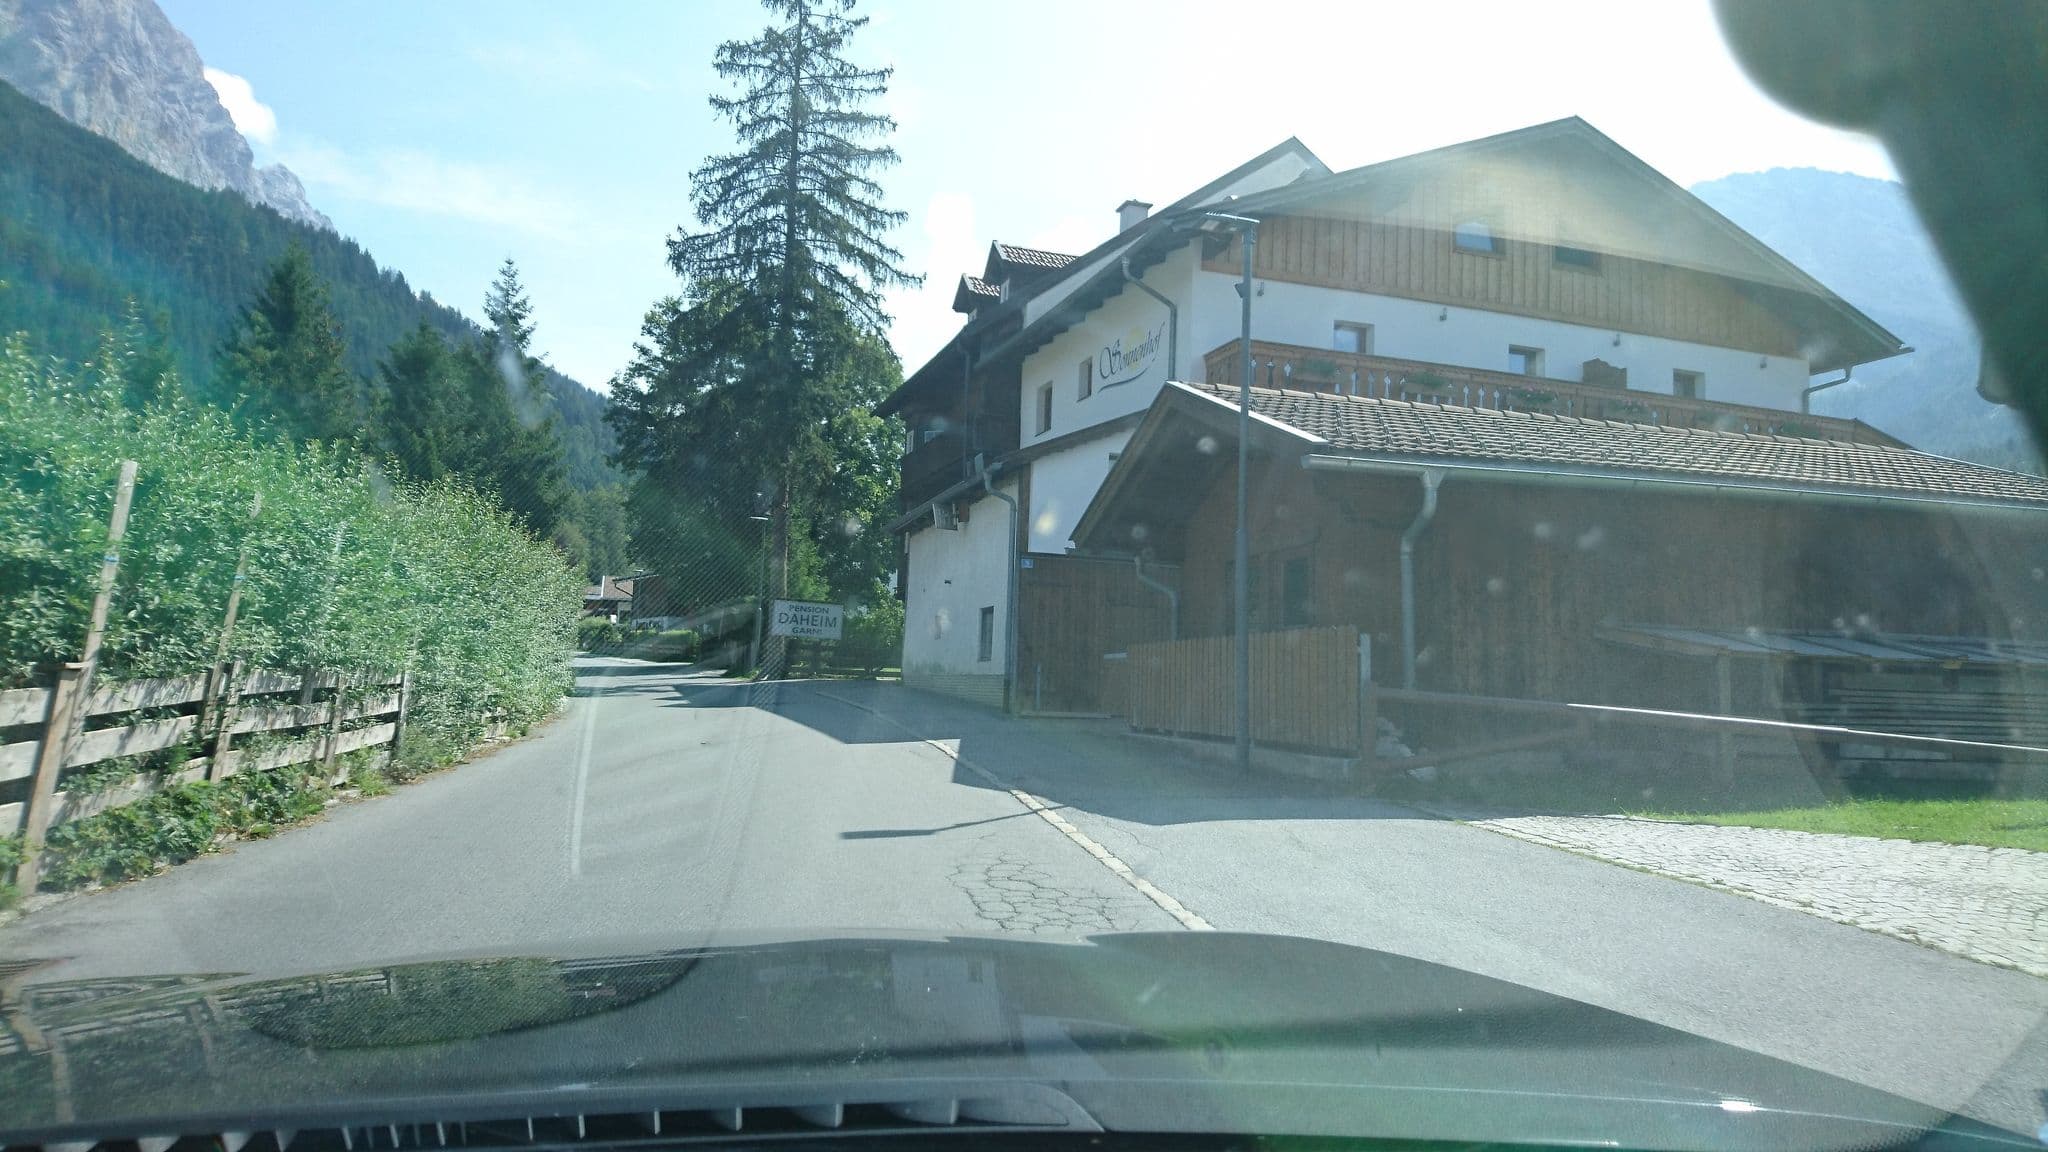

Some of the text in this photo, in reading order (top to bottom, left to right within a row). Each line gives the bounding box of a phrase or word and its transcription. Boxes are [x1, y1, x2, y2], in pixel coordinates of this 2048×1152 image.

[1099, 321, 1165, 379] Sonnenhof
[789, 604, 829, 614] PENSION
[778, 612, 837, 628] DAHEIM
